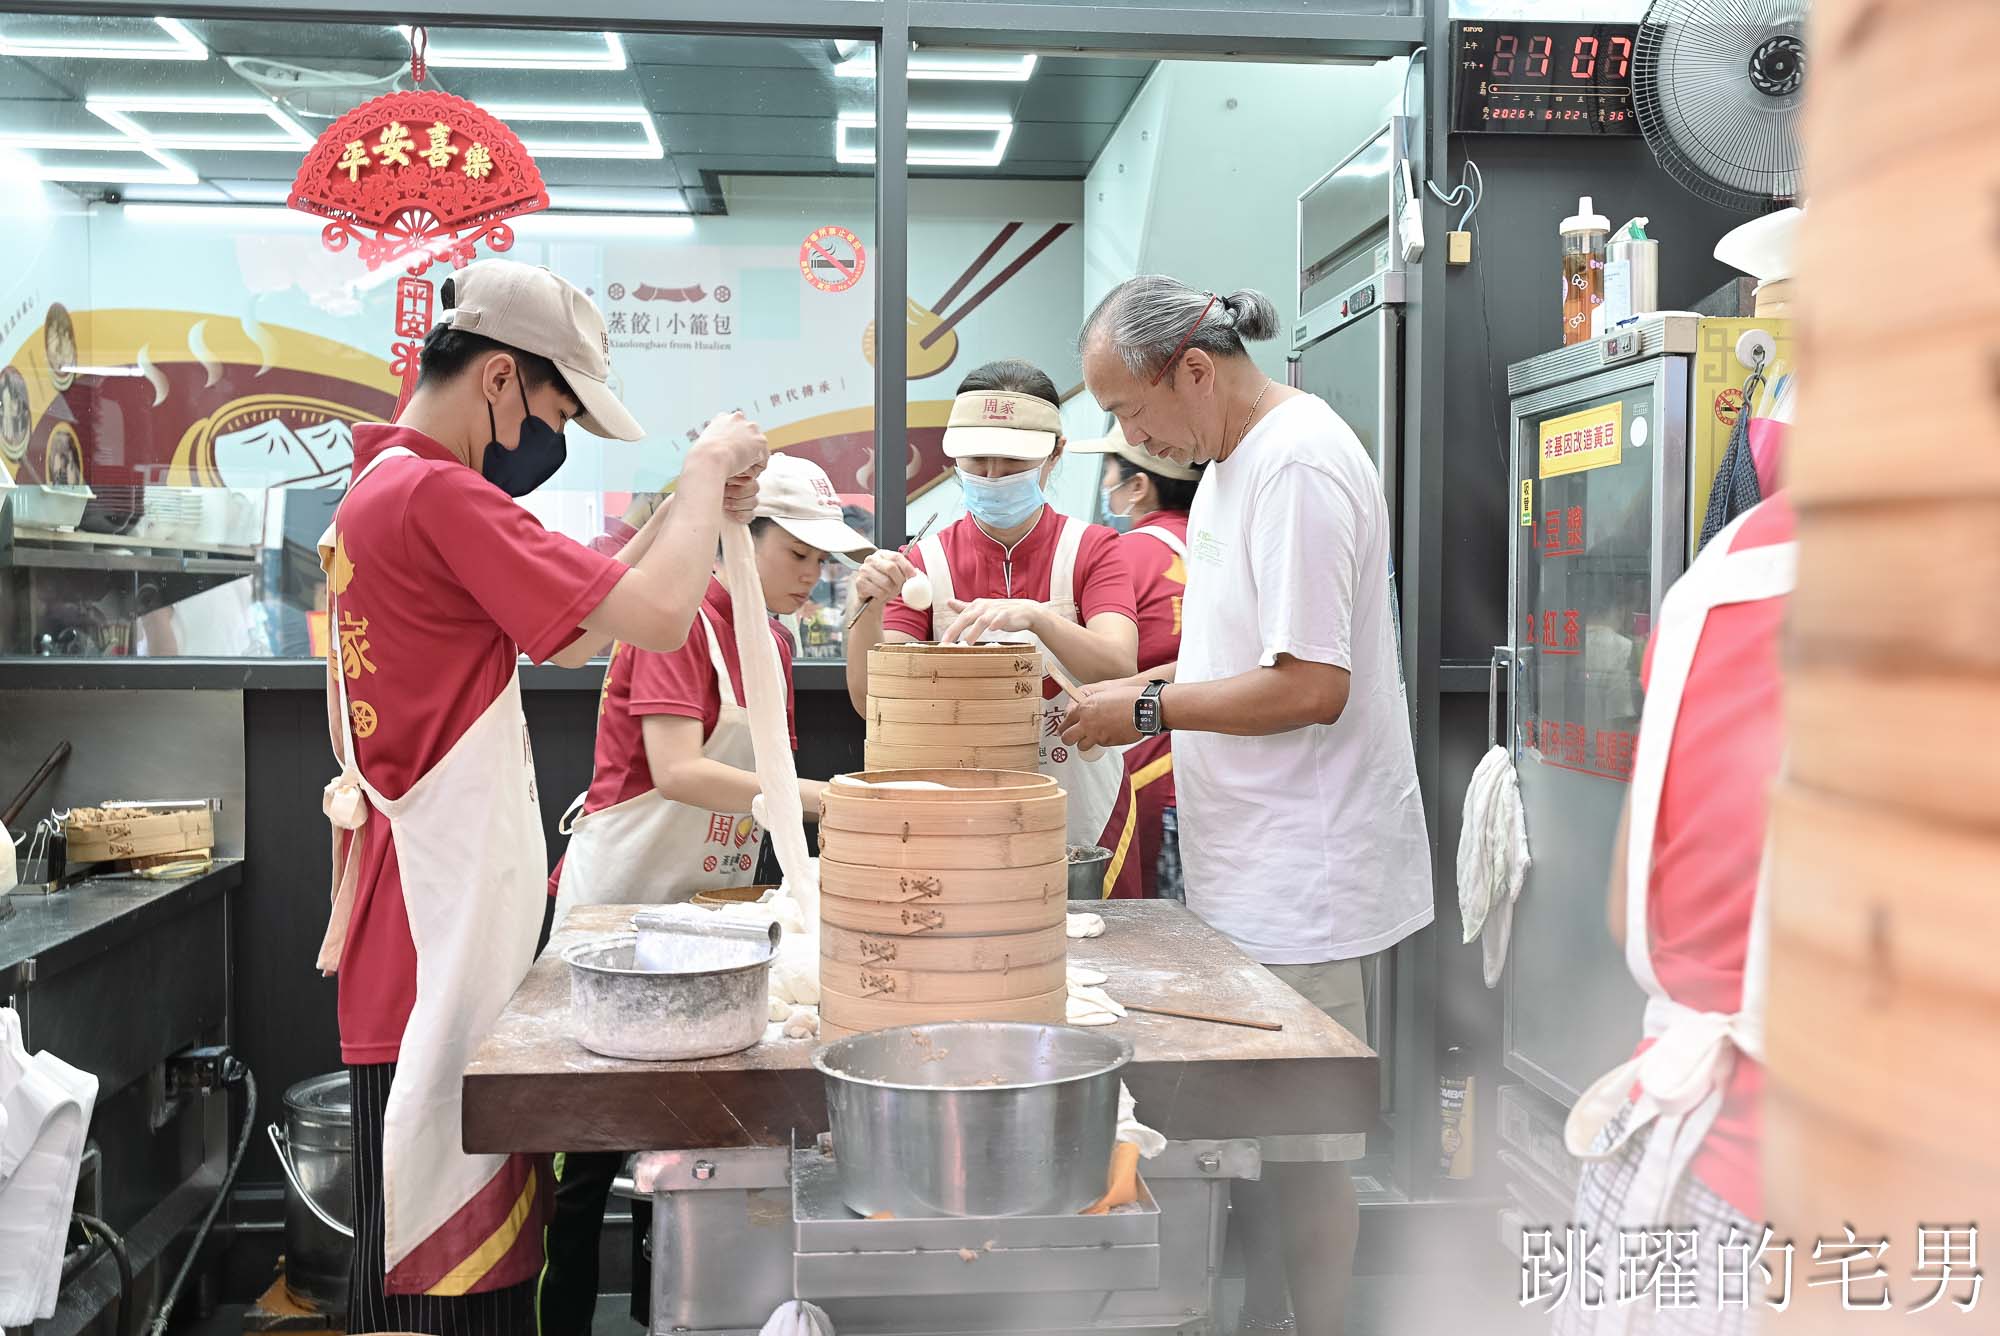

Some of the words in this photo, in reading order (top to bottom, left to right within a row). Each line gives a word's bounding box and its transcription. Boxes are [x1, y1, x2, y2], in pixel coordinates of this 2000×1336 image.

[1463, 41, 1479, 50] 上午
[1462, 62, 1476, 71] 下午
[337, 121, 494, 183] 平安喜樂
[669, 339, 692, 350] from
[694, 340, 732, 351] Hualien
[984, 398, 1016, 415] 周家
[1545, 423, 1615, 459] 非基因改造黃豆
[1545, 505, 1583, 549] 豆漿
[1542, 608, 1580, 647] 紅茶
